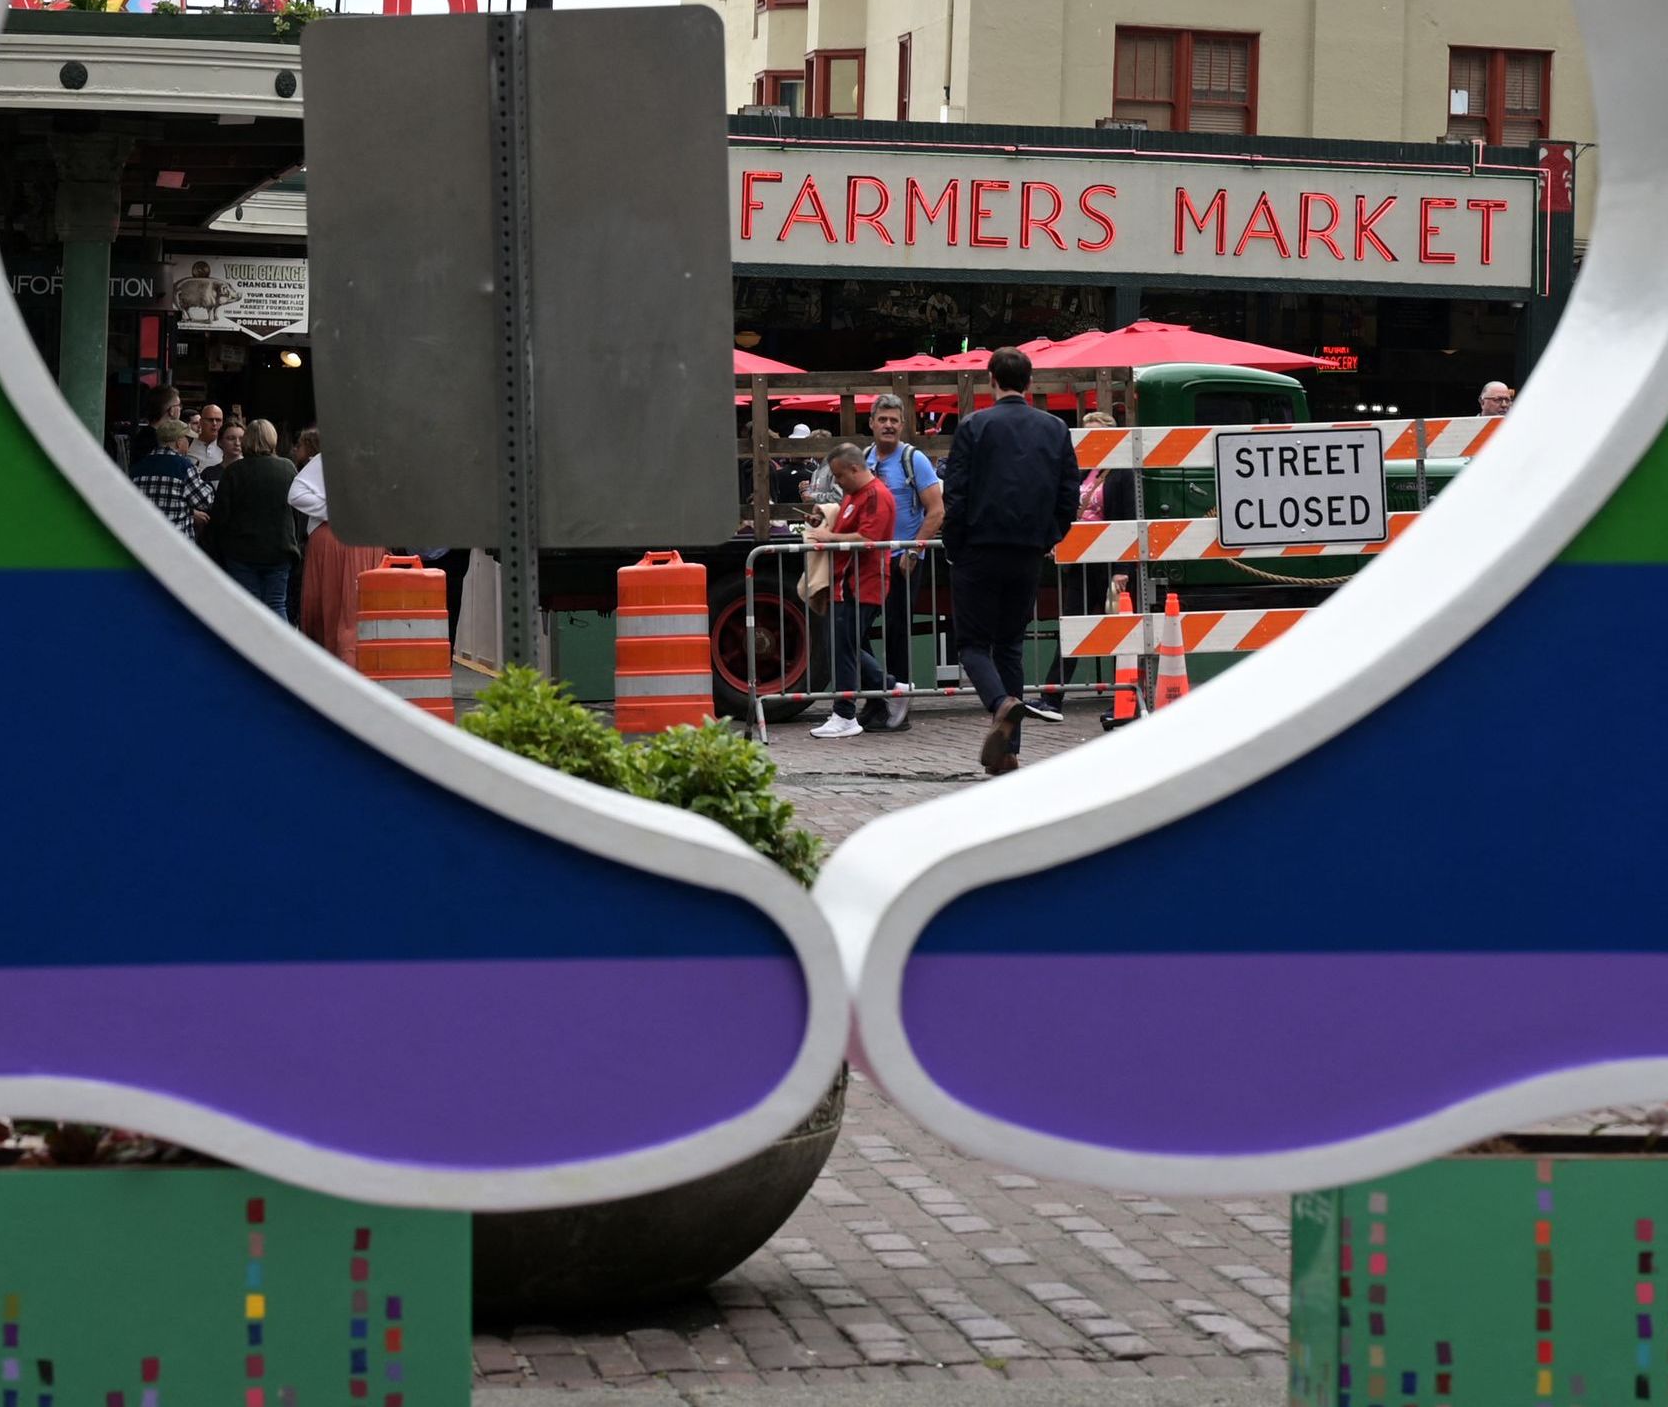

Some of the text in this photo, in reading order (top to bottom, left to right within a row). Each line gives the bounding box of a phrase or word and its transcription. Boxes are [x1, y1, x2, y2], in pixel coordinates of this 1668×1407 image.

[740, 171, 1509, 265] FARMERS MARKET
[224, 264, 306, 282] YOUR CHANGE
[237, 281, 305, 290] CHANGES LIVES!
[1235, 444, 1364, 478] STREET
[1235, 495, 1370, 530] CLOSED
